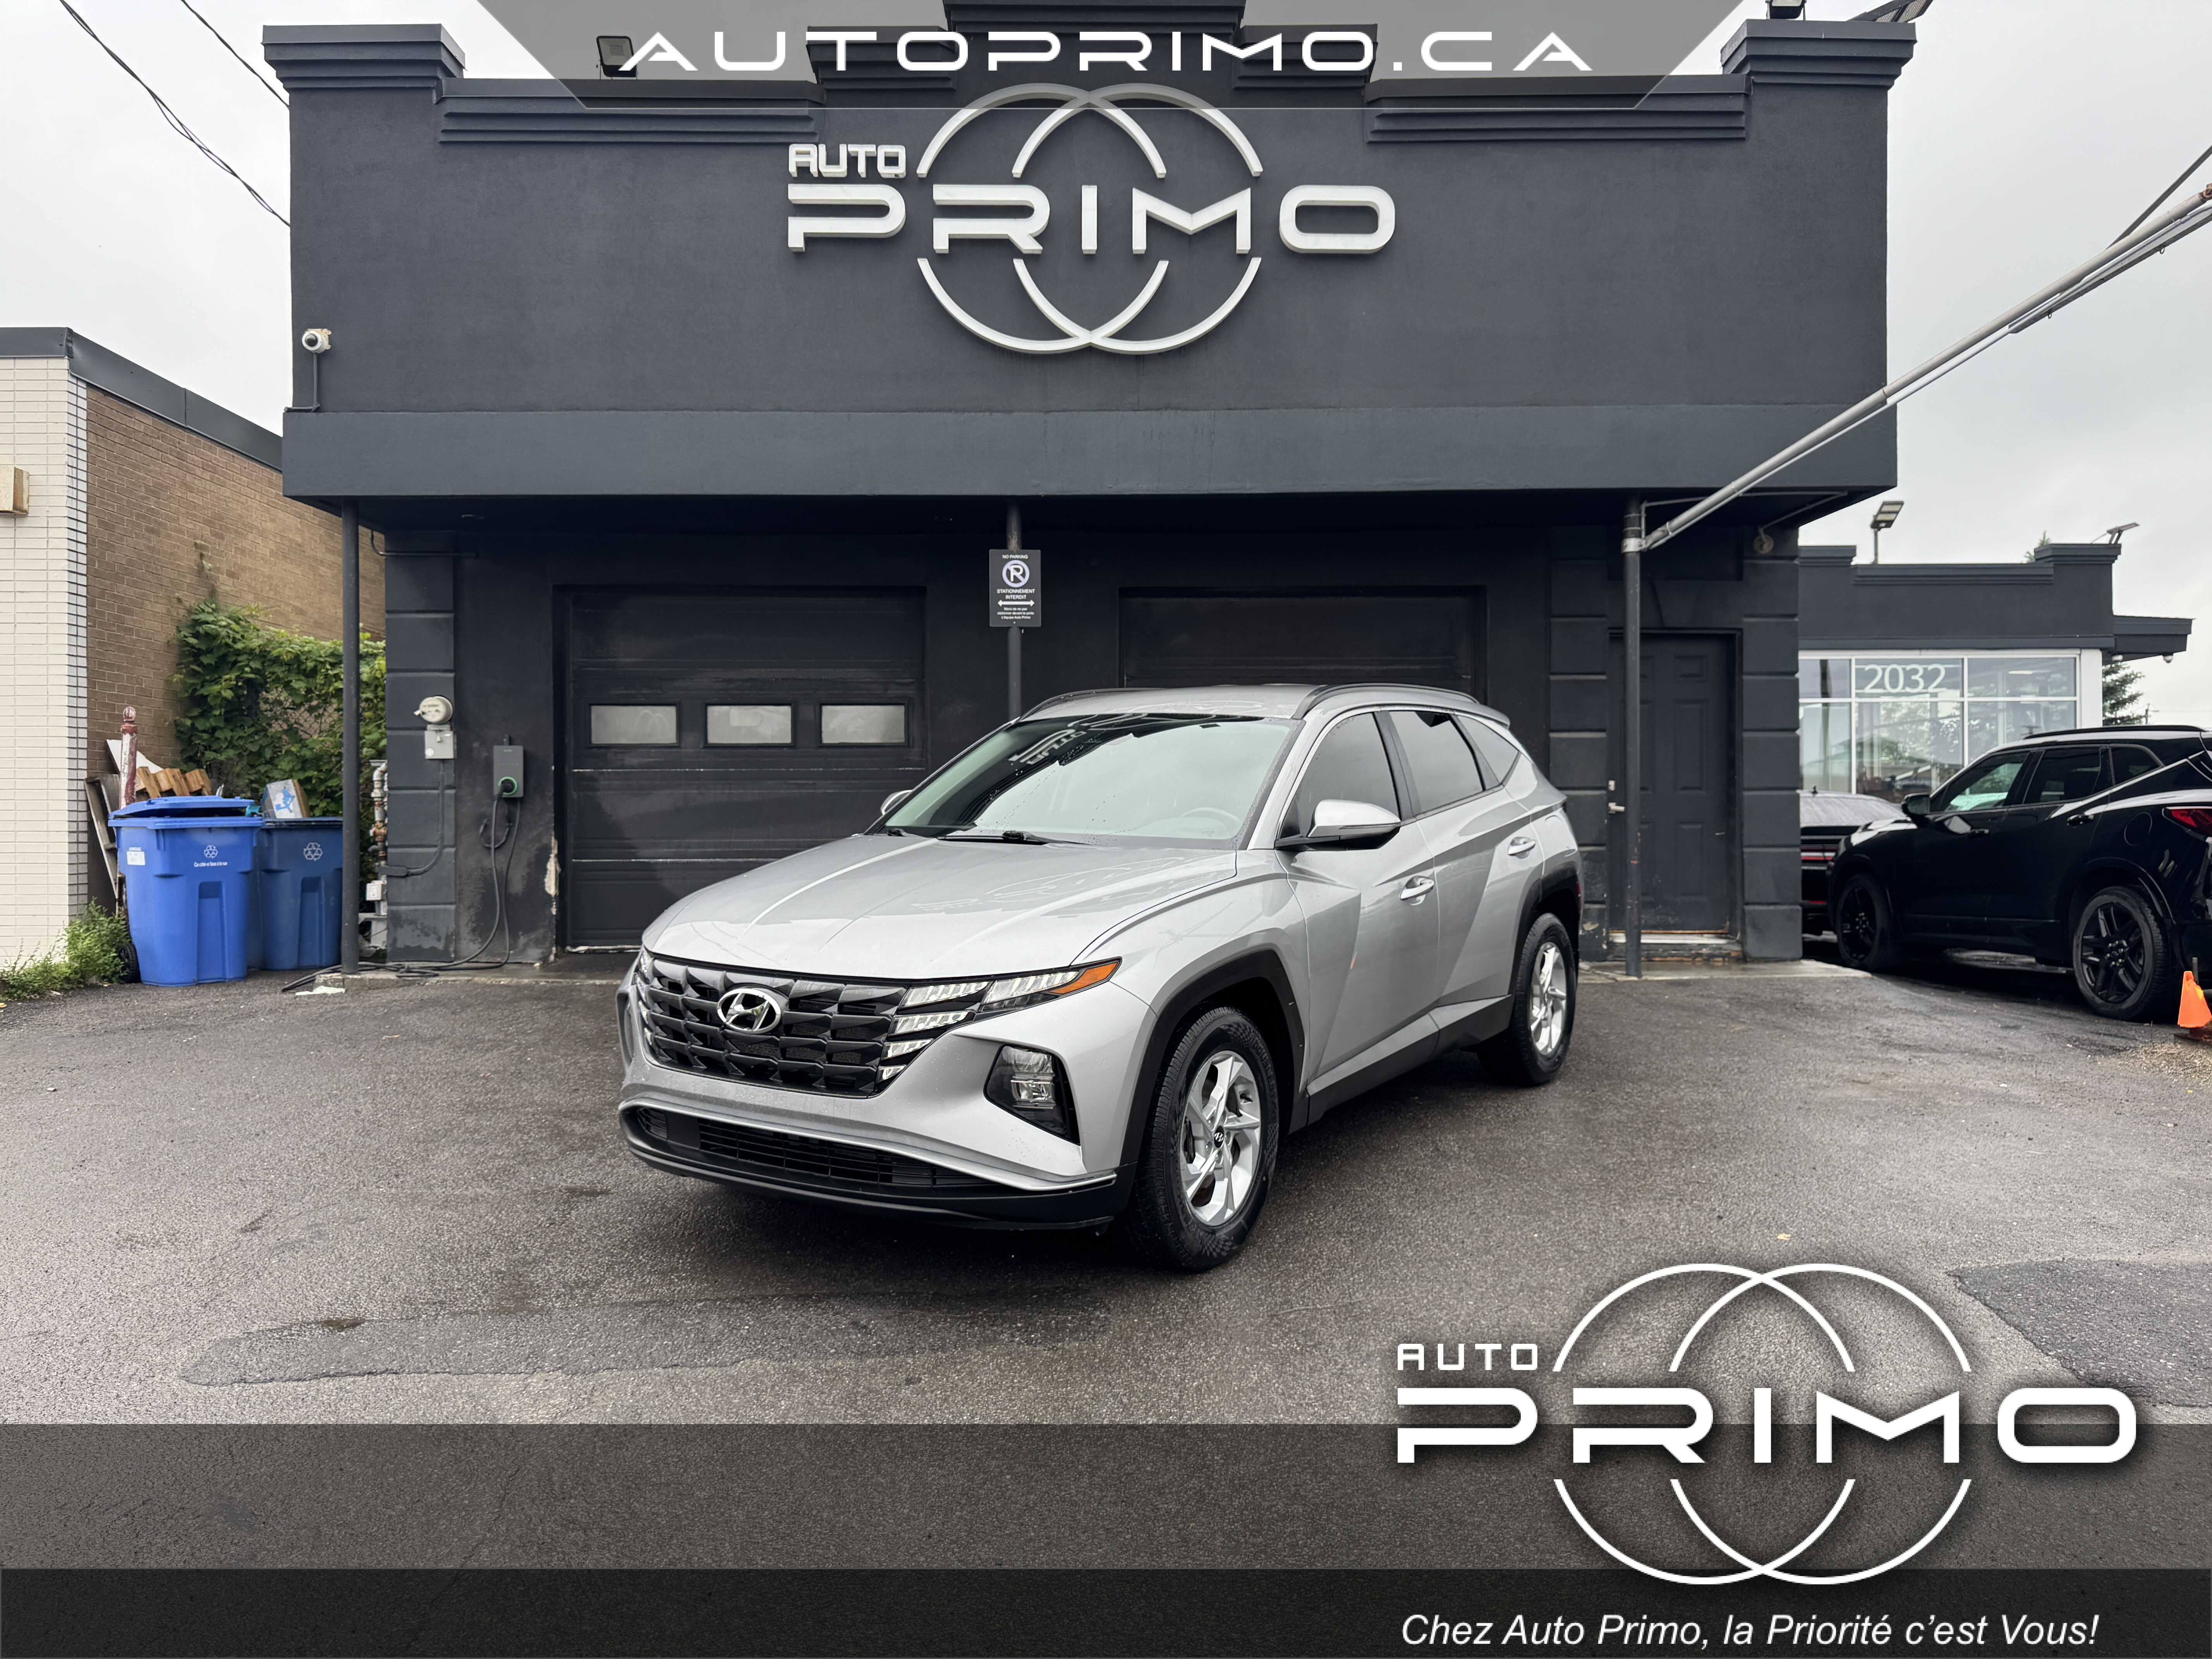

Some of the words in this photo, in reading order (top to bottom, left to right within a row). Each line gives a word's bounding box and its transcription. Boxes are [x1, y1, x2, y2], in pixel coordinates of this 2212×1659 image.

[788, 143, 907, 179] AUTO
[787, 183, 1396, 254] PRIMO
[1863, 664, 1947, 693] 2032
